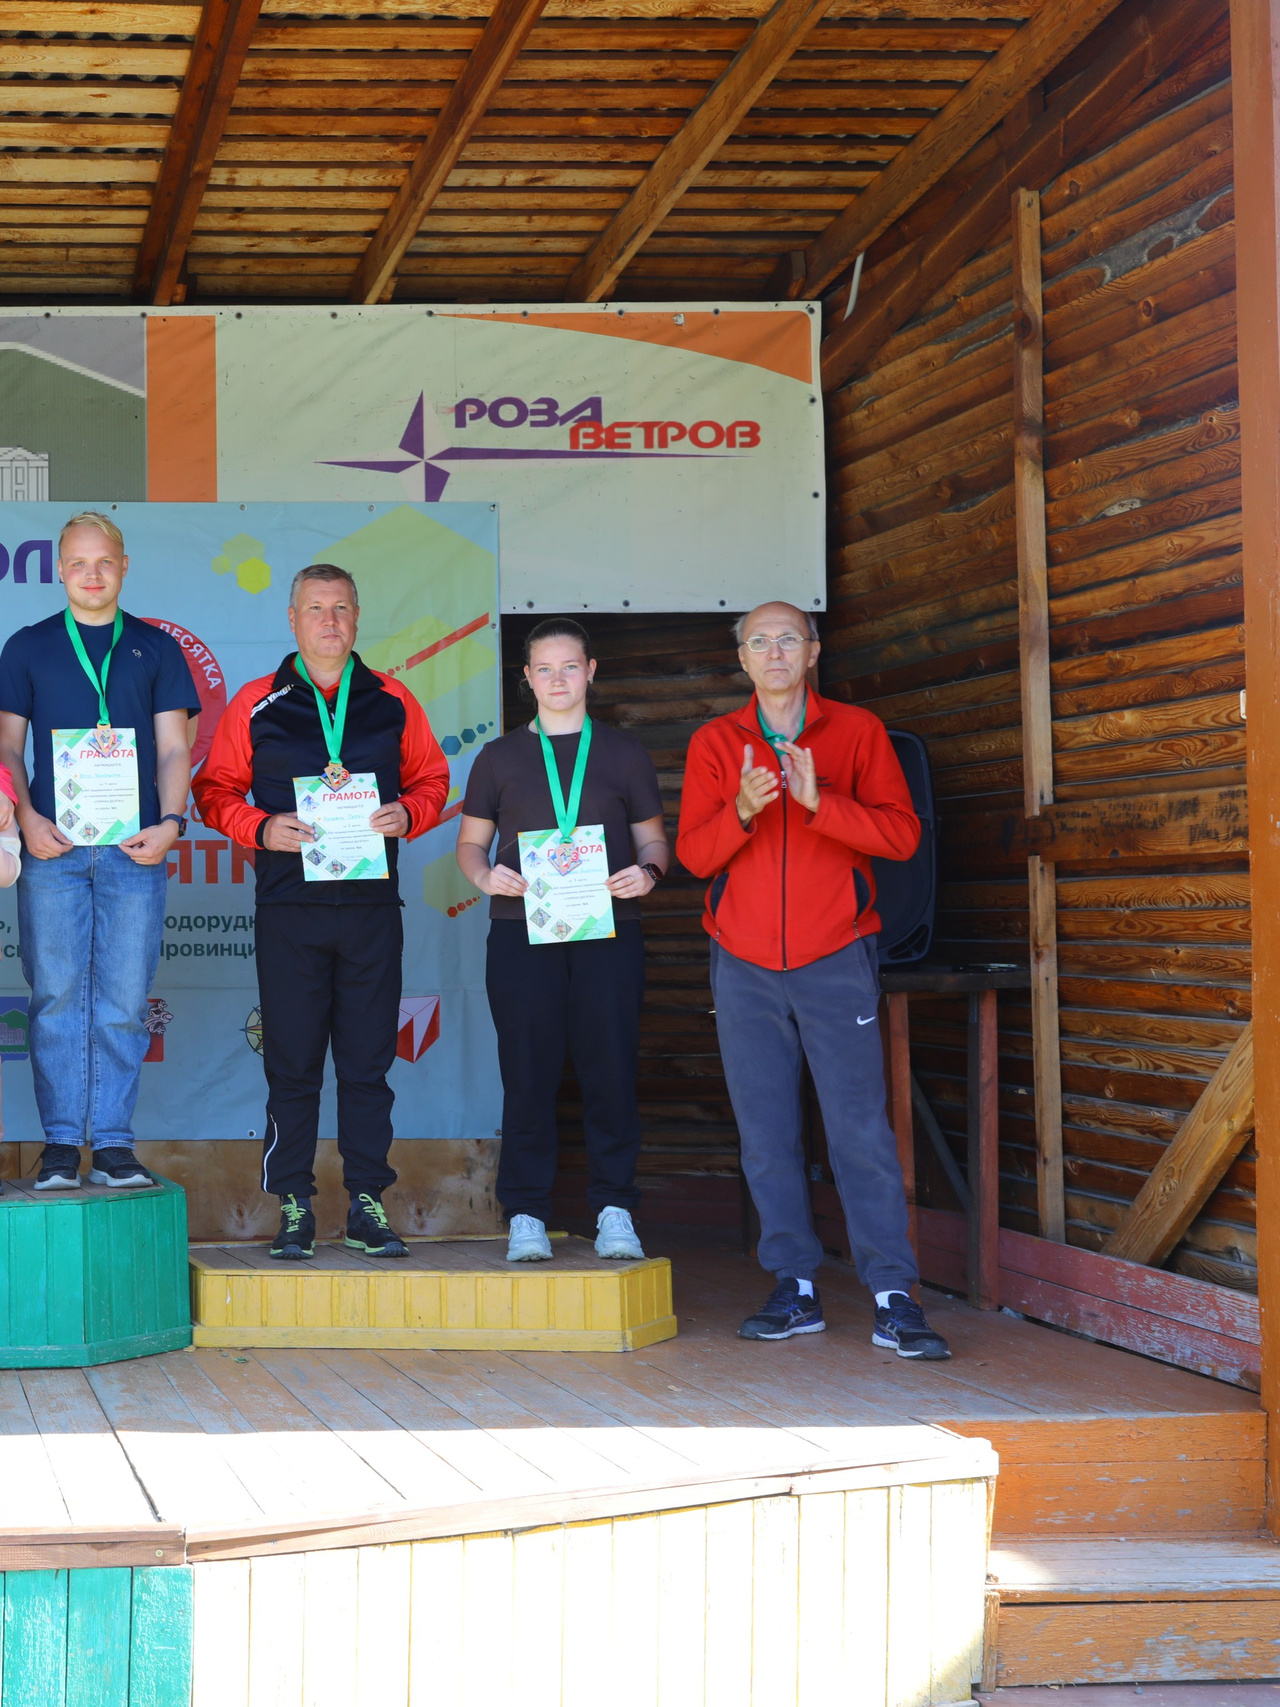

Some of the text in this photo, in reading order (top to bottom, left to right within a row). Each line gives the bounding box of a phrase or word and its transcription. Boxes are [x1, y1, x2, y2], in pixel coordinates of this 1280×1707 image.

[454, 396, 602, 428] РОЗА
[569, 420, 761, 450] ВЕТРОВ
[341, 770, 349, 779] 3
[322, 791, 377, 802] ГРАМОТА
[571, 851, 579, 861] 3
